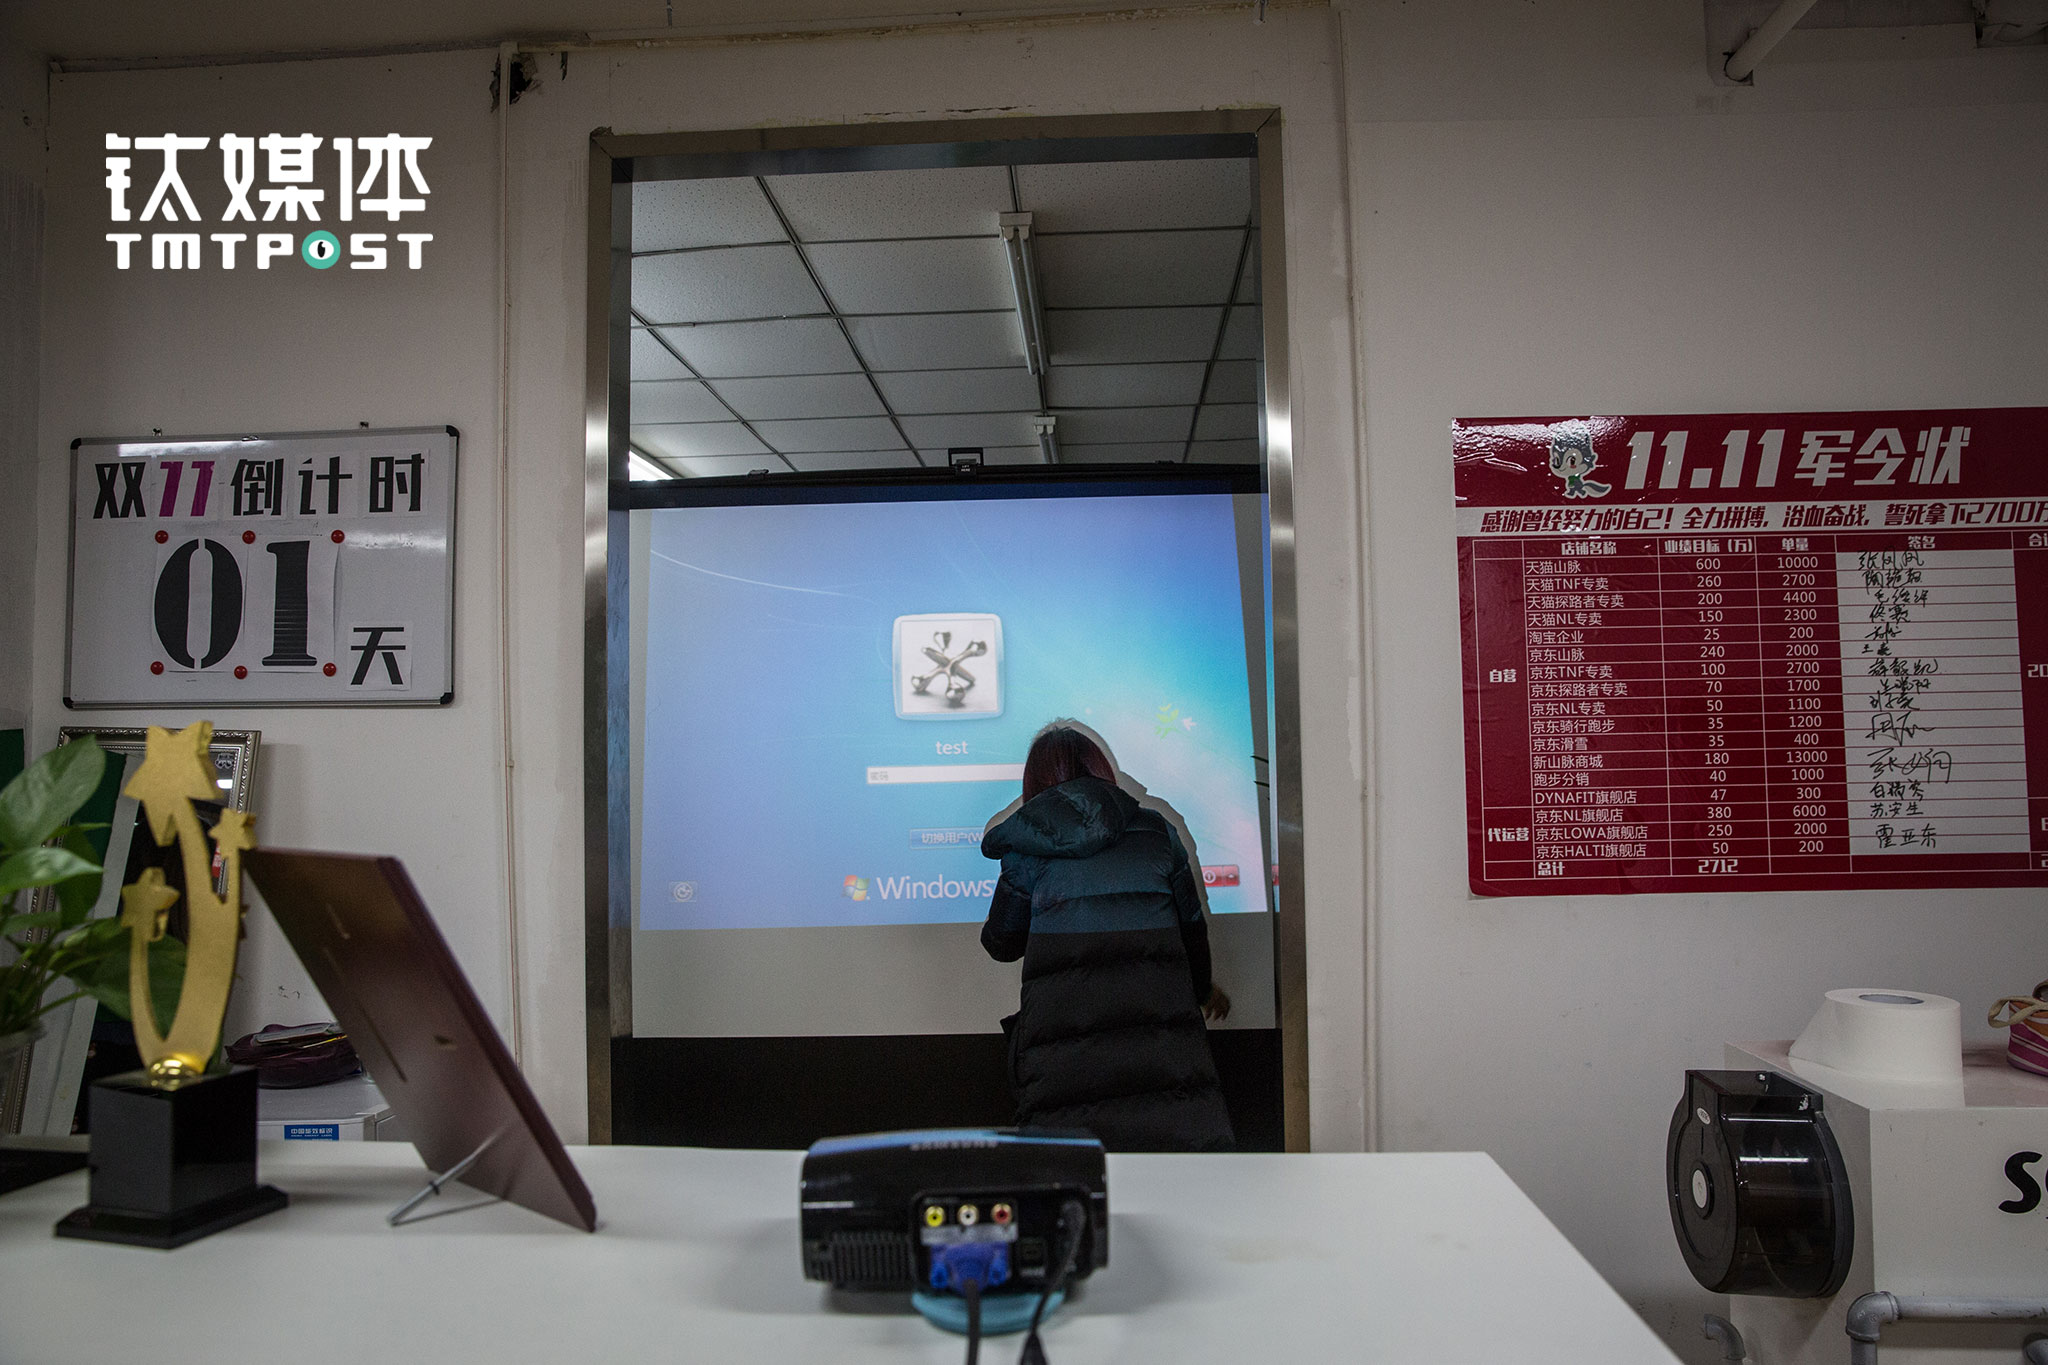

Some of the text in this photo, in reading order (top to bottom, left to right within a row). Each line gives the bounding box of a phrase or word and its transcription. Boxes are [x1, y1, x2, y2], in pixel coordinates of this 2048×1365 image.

[1560, 541, 1617, 555] 店铺名称
[1781, 538, 1809, 551] 单量
[1907, 535, 1935, 549] 签名
[1525, 557, 1818, 574] 天猫山脉 600 10000
[1526, 574, 1815, 591] 天猫TNF专卖 260 2700
[1527, 592, 1816, 609] 天猫探路者专卖 200 4400
[1528, 609, 1817, 626] 天猫NL专卖 150 2300
[1528, 627, 1814, 644] 淘宝企业 25 200
[350, 626, 406, 686] 天
[1529, 644, 1819, 662] 京东山脉 240 2000
[1489, 669, 1516, 683] 自营
[1530, 665, 1612, 679] 京东TNF专卖
[1701, 664, 1725, 675] 100
[1786, 662, 1820, 674] 2700
[1531, 679, 1820, 696] 京东探路者专卖 70 1700
[1532, 698, 1821, 715] 京东NL专卖 50 1100
[1532, 716, 1822, 733] 京东骑行跑步 35 1200
[936, 741, 968, 754] test
[1533, 733, 1819, 751] 京东滑雪 35 400
[1533, 751, 1828, 769] 新山脉商城 180 13000
[1534, 769, 1824, 786] 跑步分销 40 1000
[1535, 787, 1821, 804] DYNAFIT旗舰店 47 300
[1535, 805, 1826, 822] 京东NL旗舰店 380 6000
[1488, 823, 1827, 842] 代运营 京东LOWA旗舰店 250 2000
[1536, 841, 1824, 858] 京东HALTI旗舰店 50 200
[1537, 860, 1738, 876] 总计 2712
[877, 874, 993, 900] Windows
[1998, 1151, 2048, 1214] S
